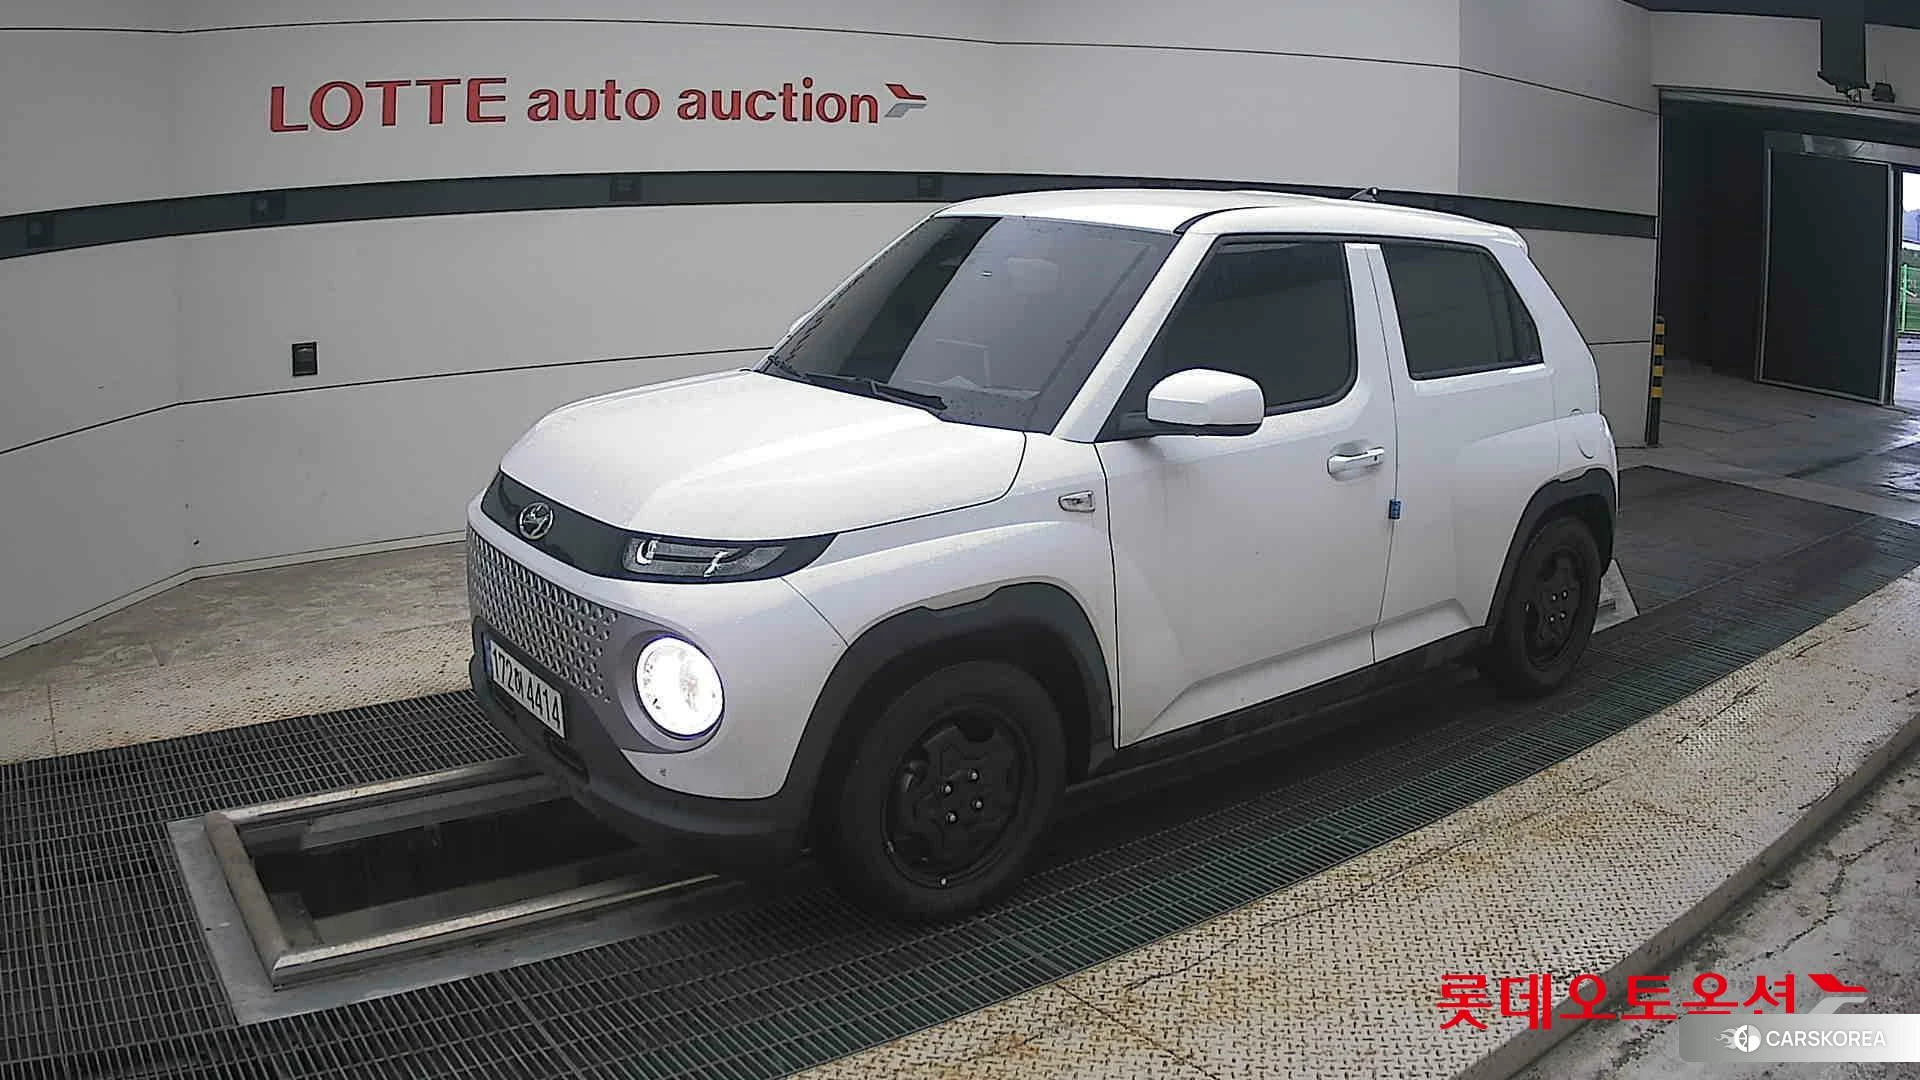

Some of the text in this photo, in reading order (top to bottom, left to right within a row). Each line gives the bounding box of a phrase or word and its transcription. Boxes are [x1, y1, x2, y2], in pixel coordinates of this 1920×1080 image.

[270, 77, 879, 132] LOTTE auto auction
